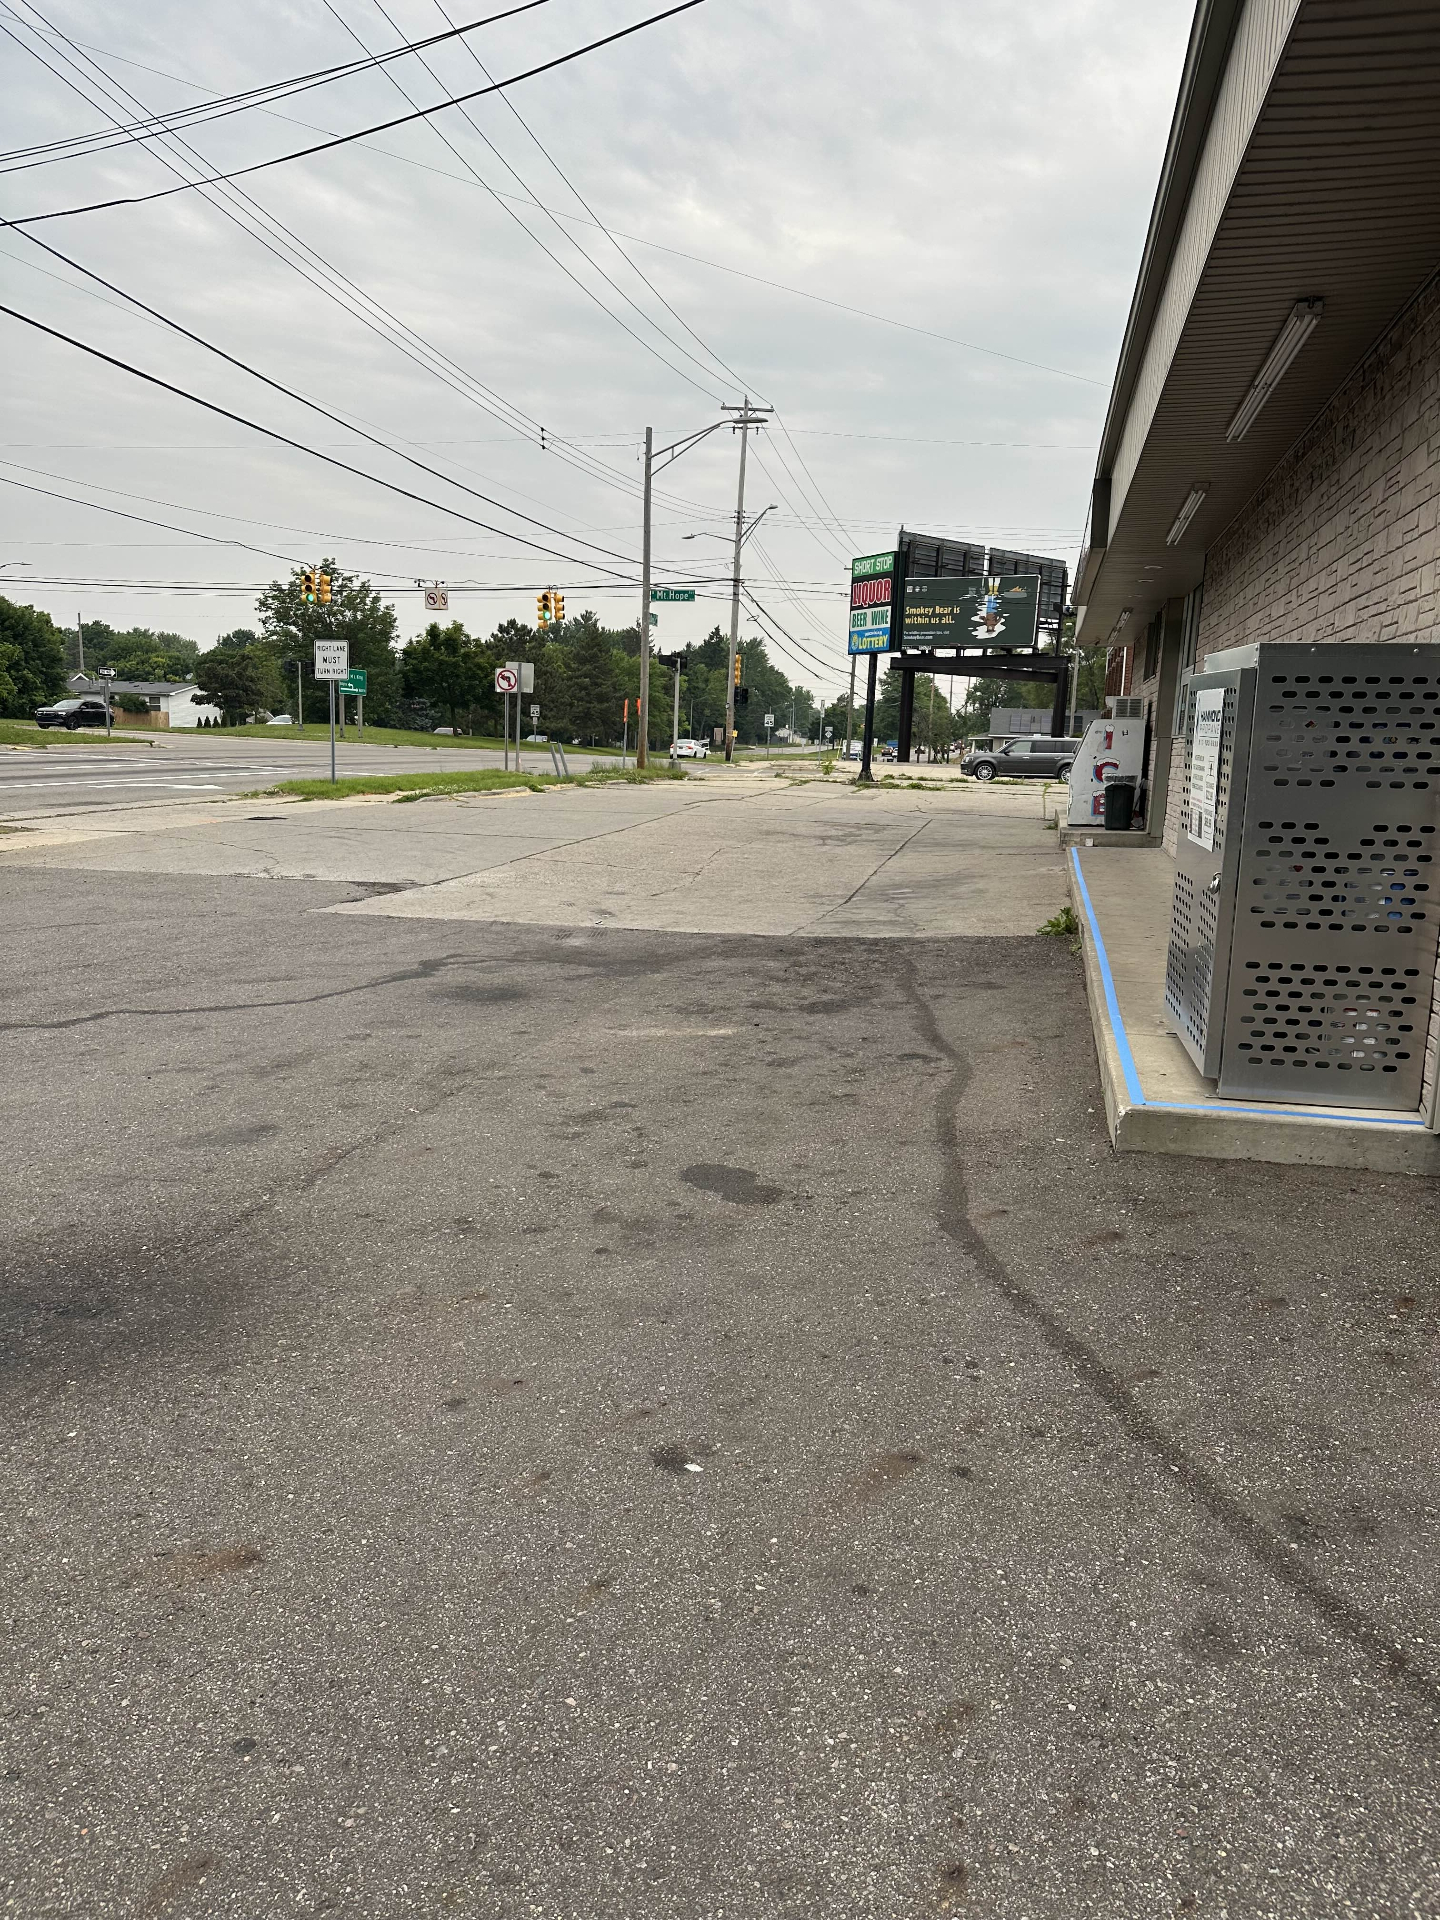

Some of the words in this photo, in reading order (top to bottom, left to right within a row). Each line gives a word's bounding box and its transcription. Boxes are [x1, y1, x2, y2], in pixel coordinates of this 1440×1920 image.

[854, 559, 874, 574] SHORT
[875, 556, 892, 570] STOP
[656, 590, 669, 599] Mt.
[669, 590, 689, 601] Hope
[852, 578, 891, 607] LIQUOR
[905, 606, 934, 616] Smokey
[935, 605, 952, 614] Bear
[953, 604, 961, 614] is
[852, 612, 867, 628] BEER
[871, 609, 889, 626] WINE
[905, 615, 930, 624] within
[941, 615, 956, 624] all.
[858, 635, 888, 649] LOTTERY
[322, 656, 340, 664] MUST
